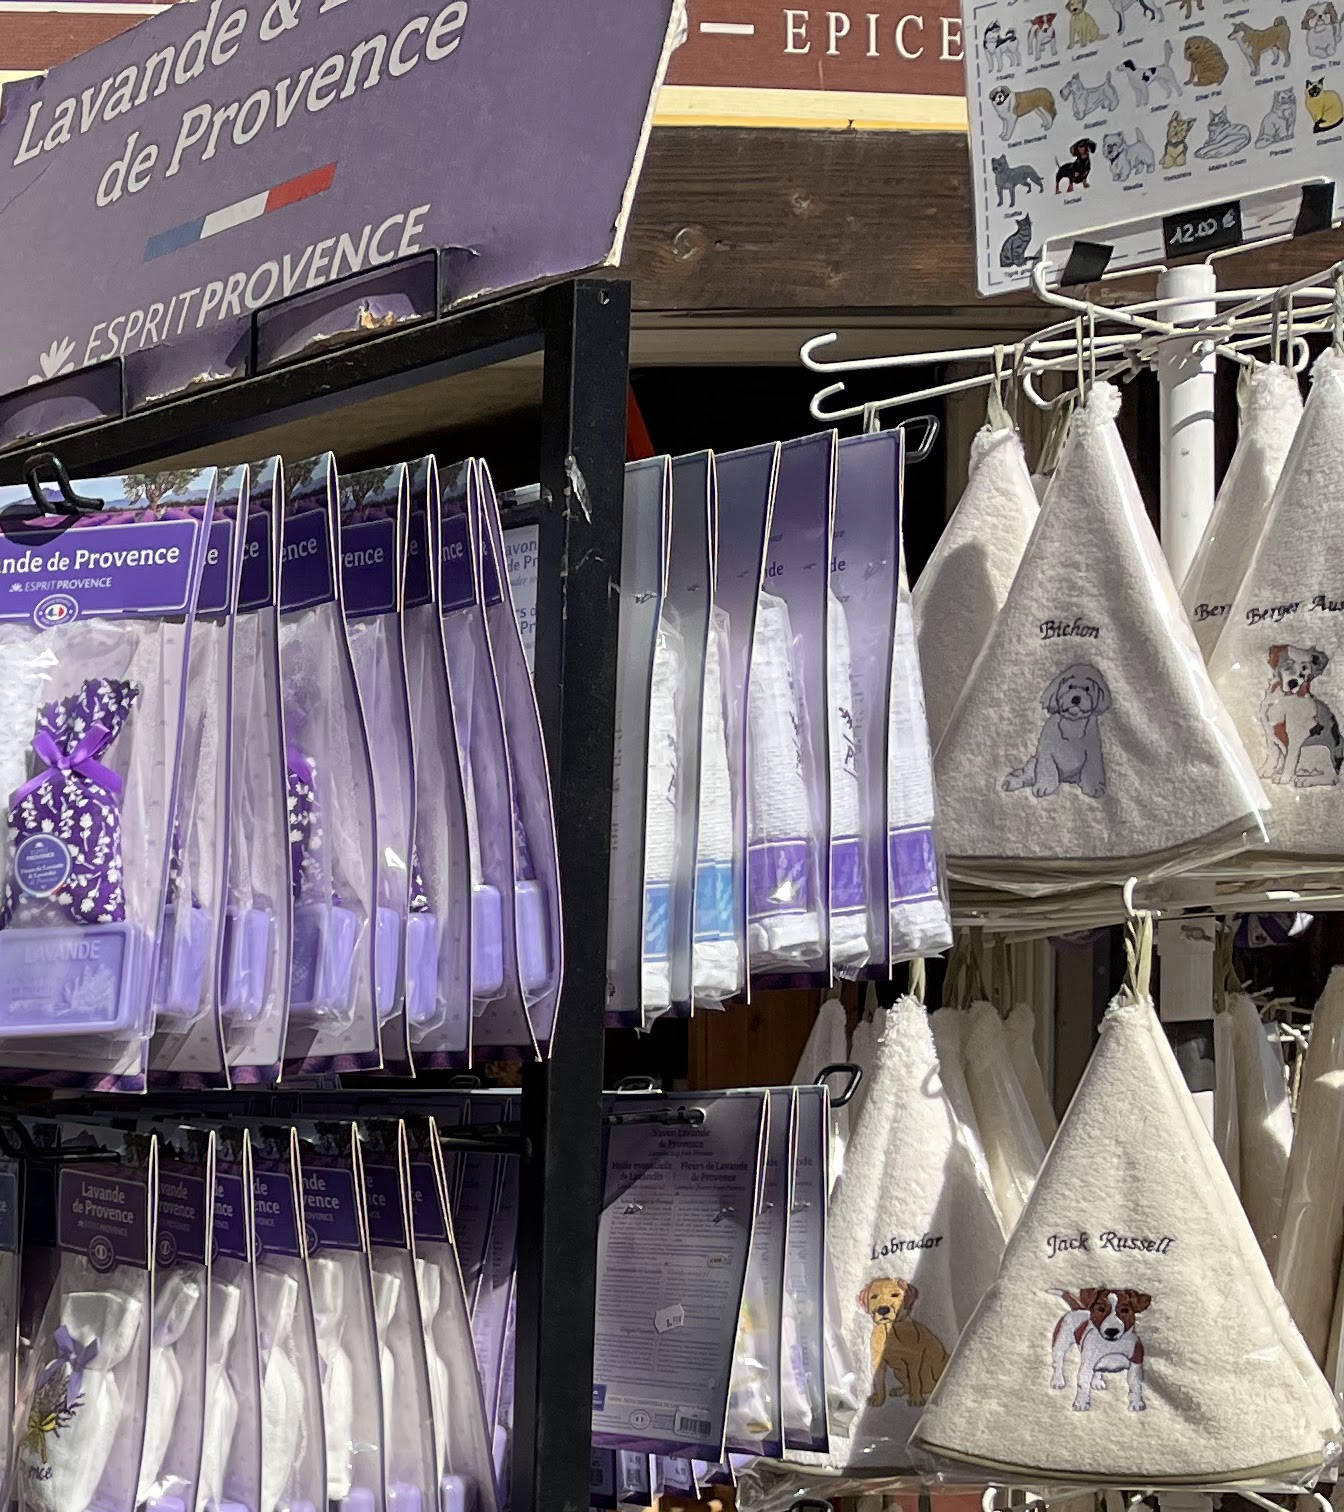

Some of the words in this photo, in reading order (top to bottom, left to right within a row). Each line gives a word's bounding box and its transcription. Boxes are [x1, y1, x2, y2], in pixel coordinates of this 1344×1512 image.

[13, 0, 248, 168] Lavande
[95, 133, 159, 210] de
[166, 0, 467, 177] Provence
[46, 551, 70, 572] de
[74, 546, 180, 570] Provence
[1246, 601, 1301, 625] Berger
[1039, 617, 1101, 641] Bichon
[81, 1180, 126, 1205] Lavande
[72, 1199, 85, 1214] de
[84, 1200, 135, 1225] Provence
[869, 1231, 944, 1261] Labrador
[1046, 1231, 1089, 1259] Jack
[1099, 1230, 1175, 1256] Russell
